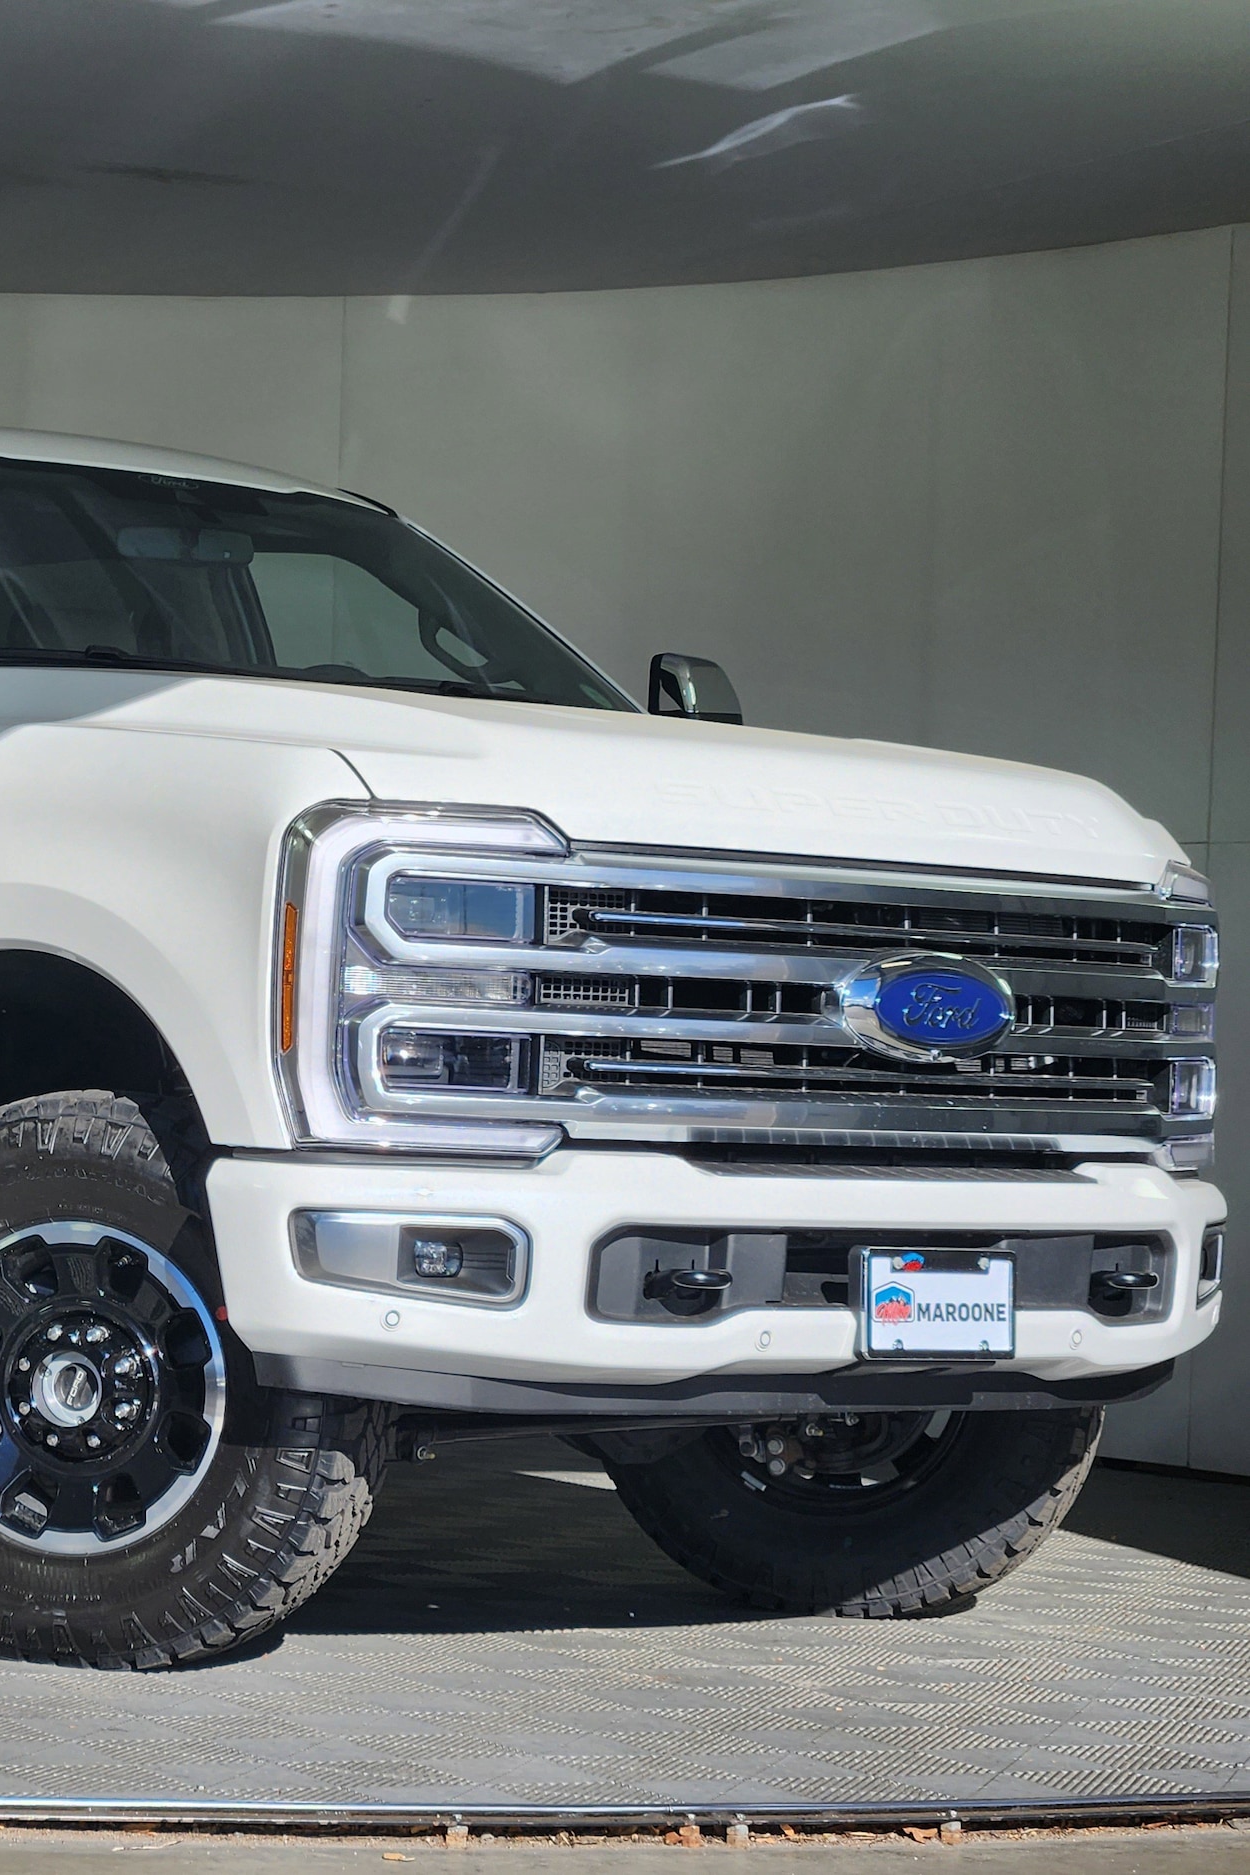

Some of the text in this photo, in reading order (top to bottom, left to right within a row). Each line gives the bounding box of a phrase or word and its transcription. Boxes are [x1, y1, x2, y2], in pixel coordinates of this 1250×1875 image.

[654, 778, 1101, 839] SUPER DUTY
[902, 982, 983, 1030] Ford
[916, 1302, 1008, 1323] MAROONE
[66, 1370, 85, 1406] FORD
